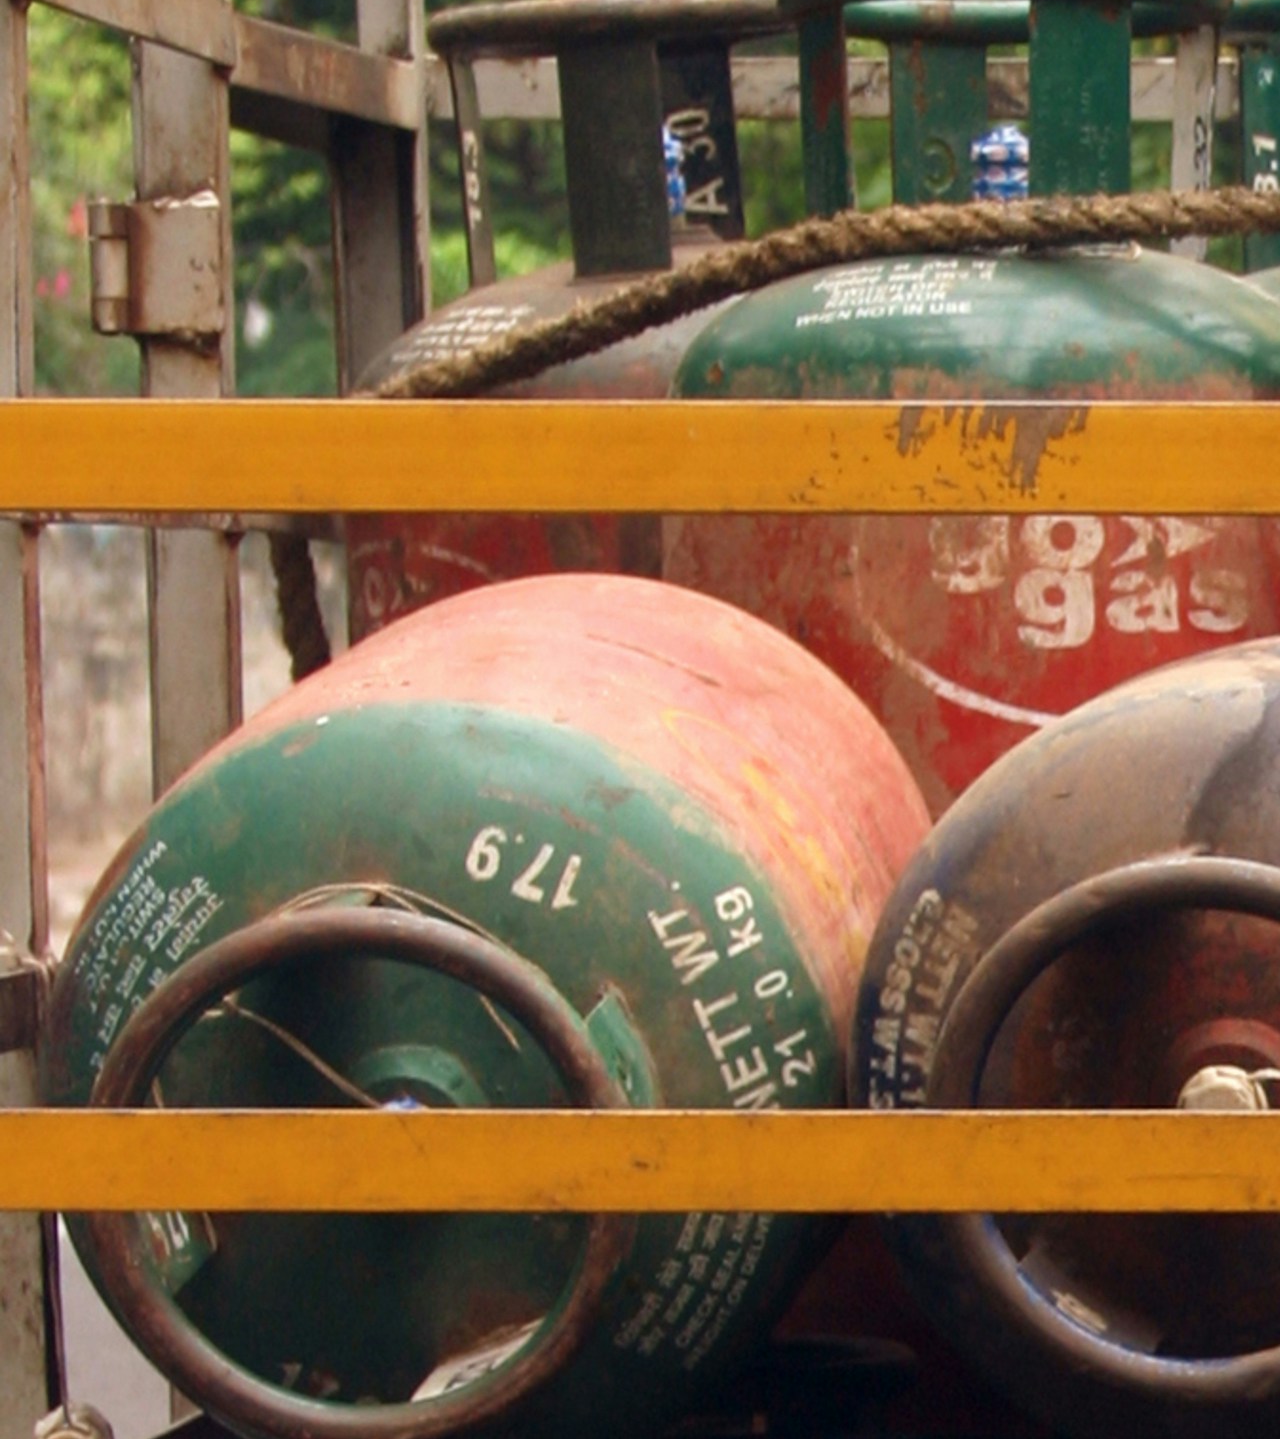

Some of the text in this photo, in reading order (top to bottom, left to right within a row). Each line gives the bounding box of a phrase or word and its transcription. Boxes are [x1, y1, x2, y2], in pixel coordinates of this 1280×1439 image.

[1013, 567, 1248, 649] gas
[464, 824, 582, 909] 17.9
[713, 885, 763, 958] kg
[647, 880, 783, 1110] NETT WT.
